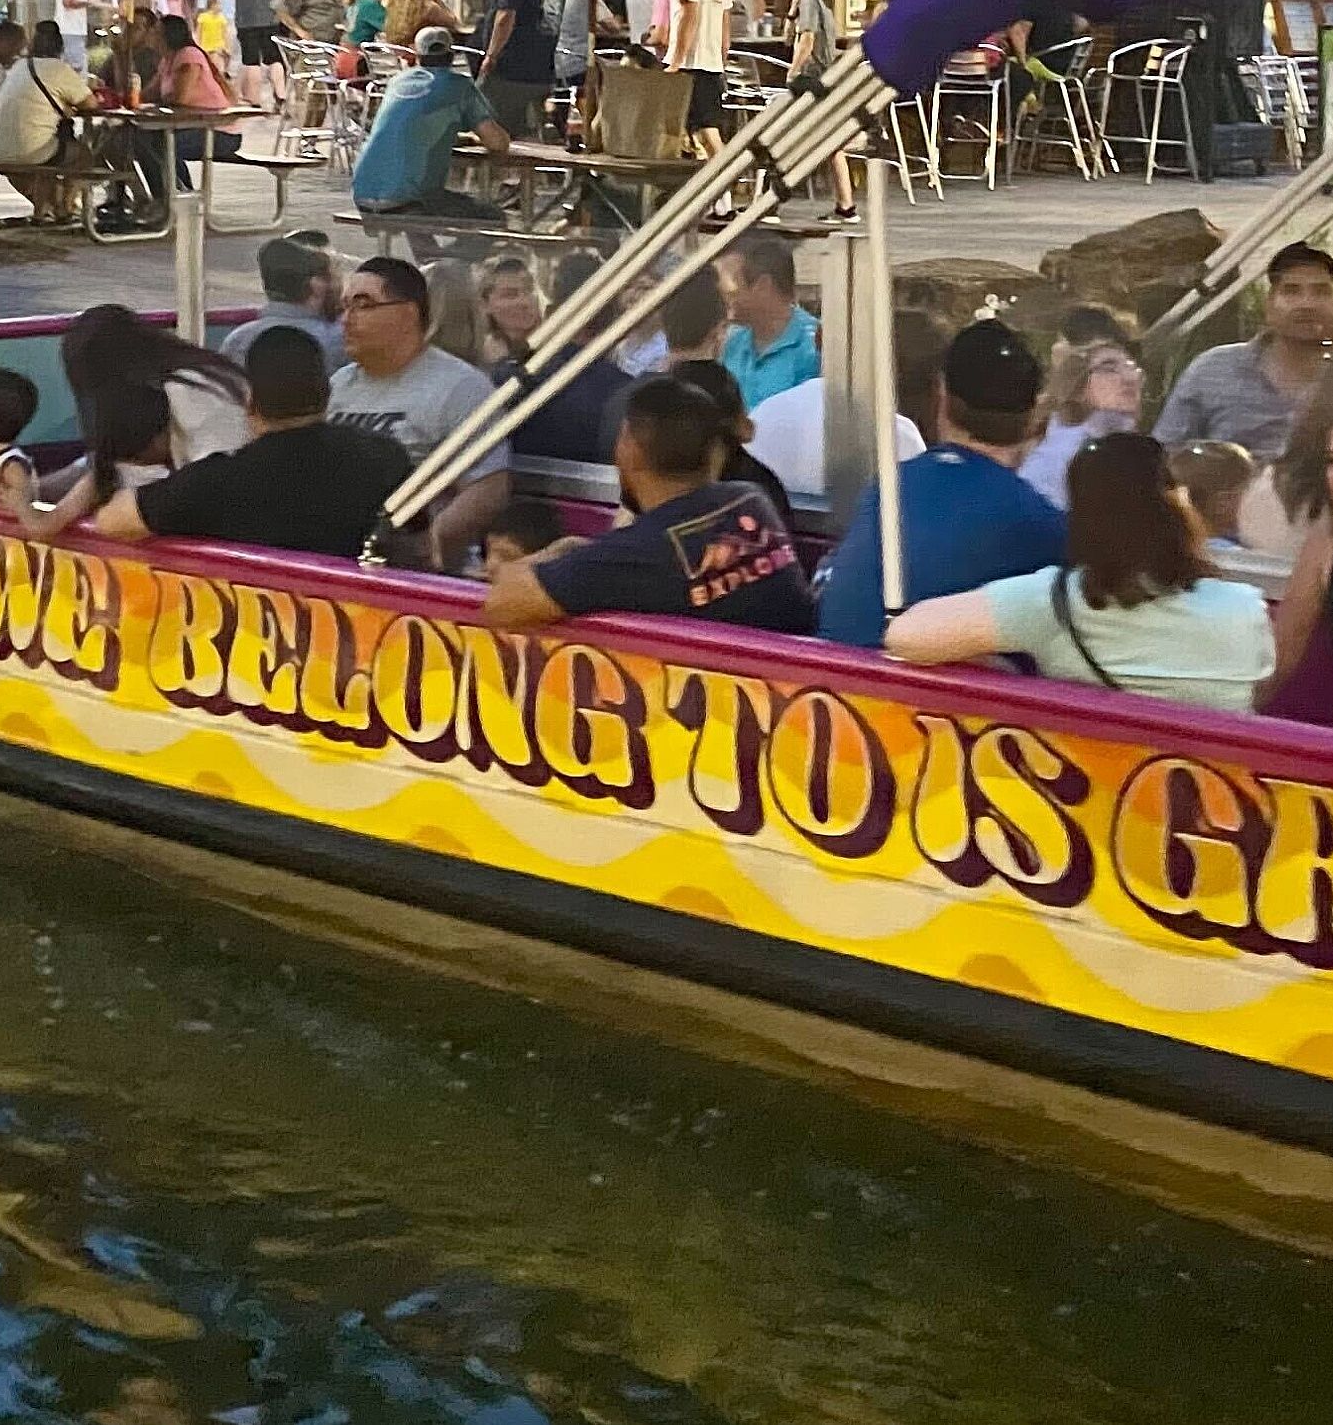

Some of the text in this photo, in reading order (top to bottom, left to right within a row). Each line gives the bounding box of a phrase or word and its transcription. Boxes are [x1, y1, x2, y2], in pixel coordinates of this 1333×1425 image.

[150, 568, 655, 810] BELONG
[664, 664, 897, 858] TO
[912, 711, 1096, 908] IS
